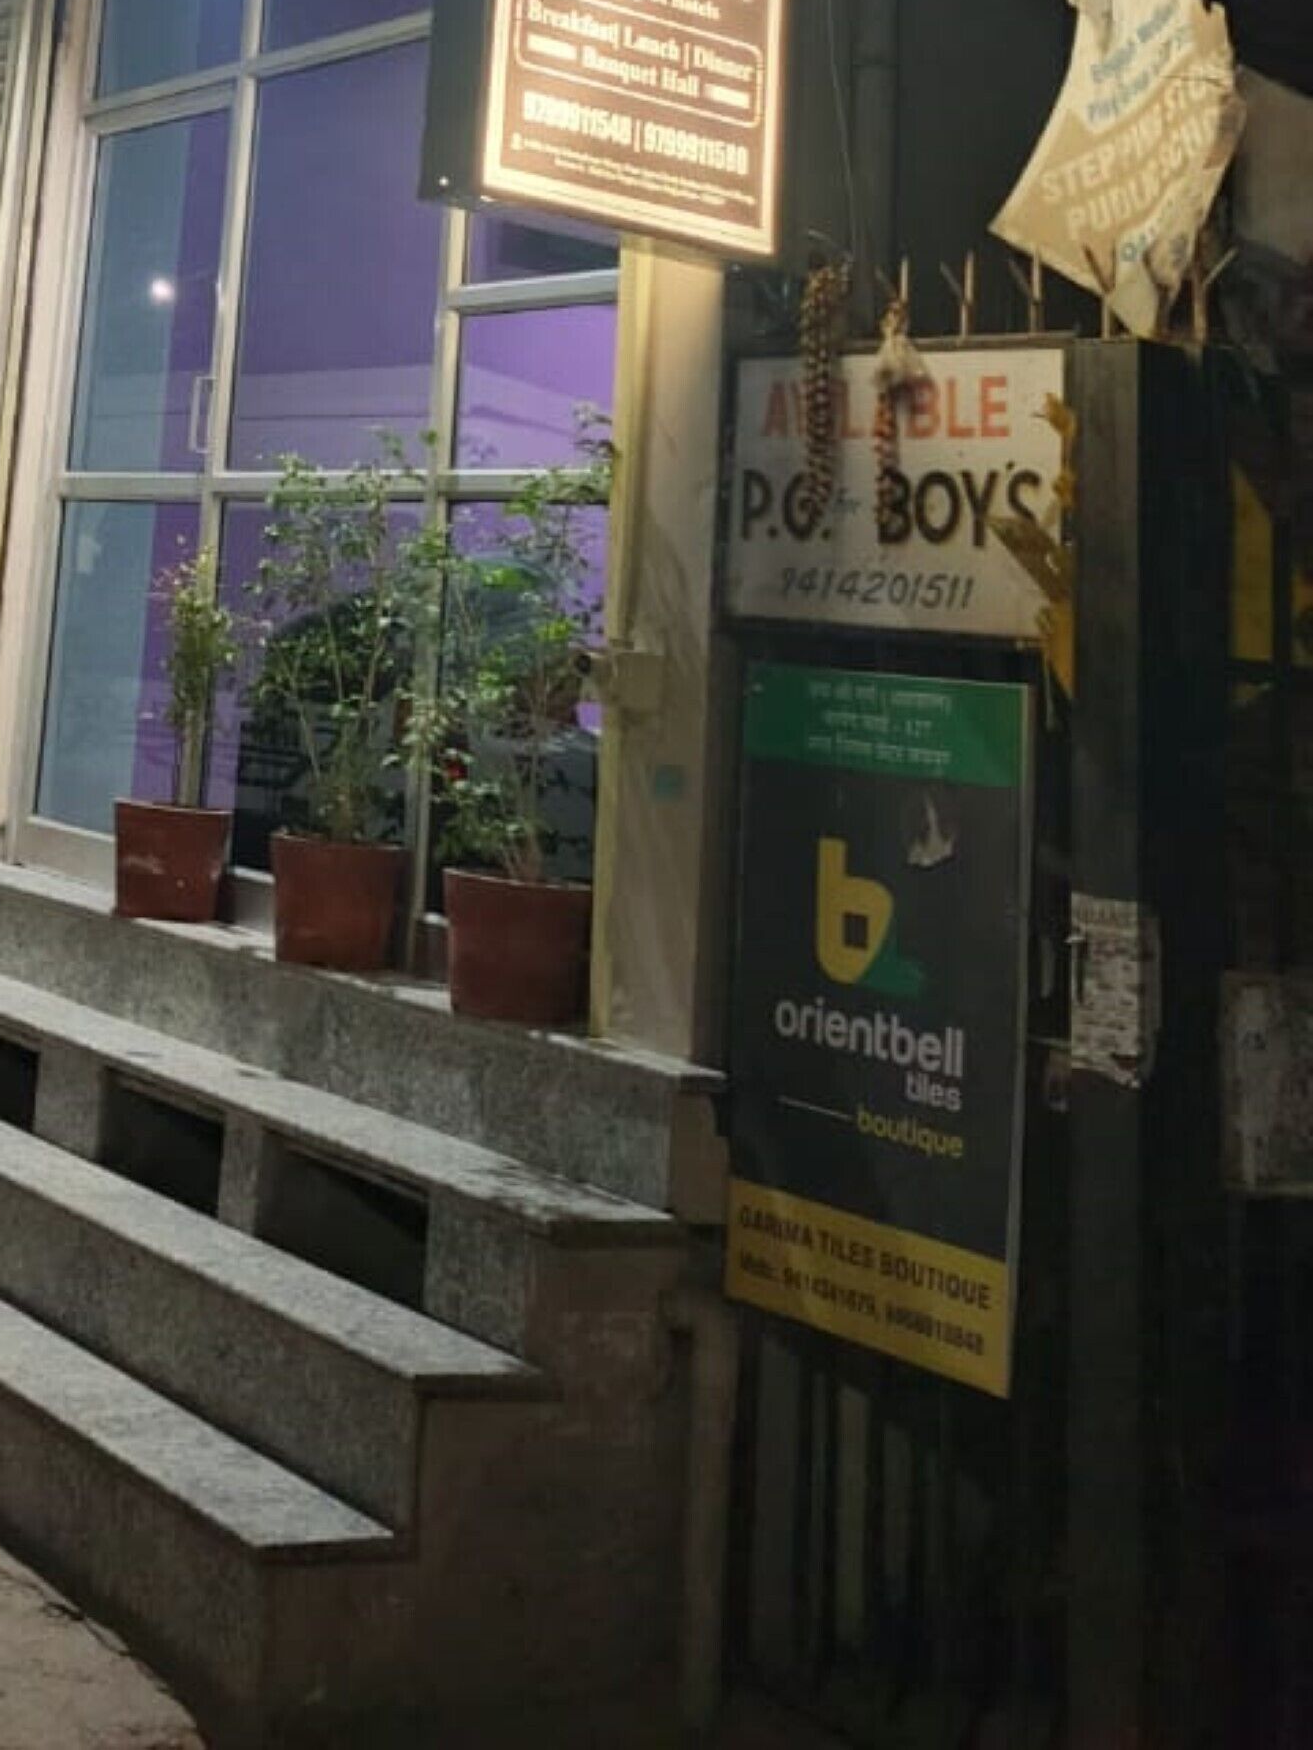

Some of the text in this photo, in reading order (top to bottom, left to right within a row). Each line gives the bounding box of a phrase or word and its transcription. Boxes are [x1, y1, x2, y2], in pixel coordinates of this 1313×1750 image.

[624, 25, 680, 62] Lunch
[693, 46, 754, 82] Dinner
[661, 67, 700, 97] Hall
[775, 996, 964, 1078] orientbell
[905, 1070, 962, 1113] tiles
[856, 1105, 964, 1159] boutique
[819, 1228, 875, 1268] TILES
[879, 1249, 993, 1310] BOUTIQUE
